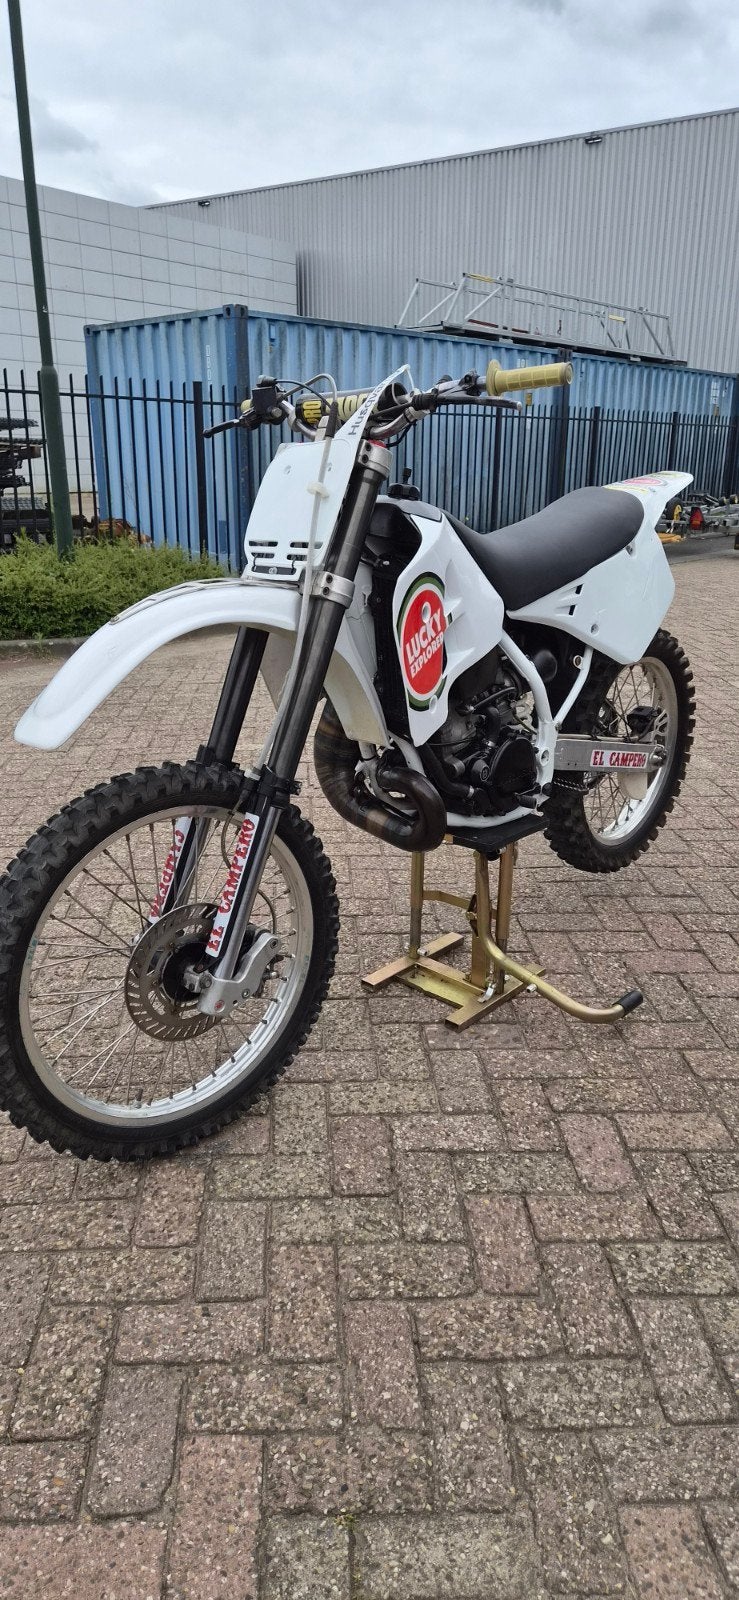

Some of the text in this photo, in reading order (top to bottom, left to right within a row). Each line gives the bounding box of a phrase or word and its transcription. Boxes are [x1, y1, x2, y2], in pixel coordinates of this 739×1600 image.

[347, 374, 394, 436] Husqva
[406, 608, 442, 665] LUCKY
[593, 751, 646, 767] EL CAMPERO
[207, 818, 255, 952] EL CAMPERO
